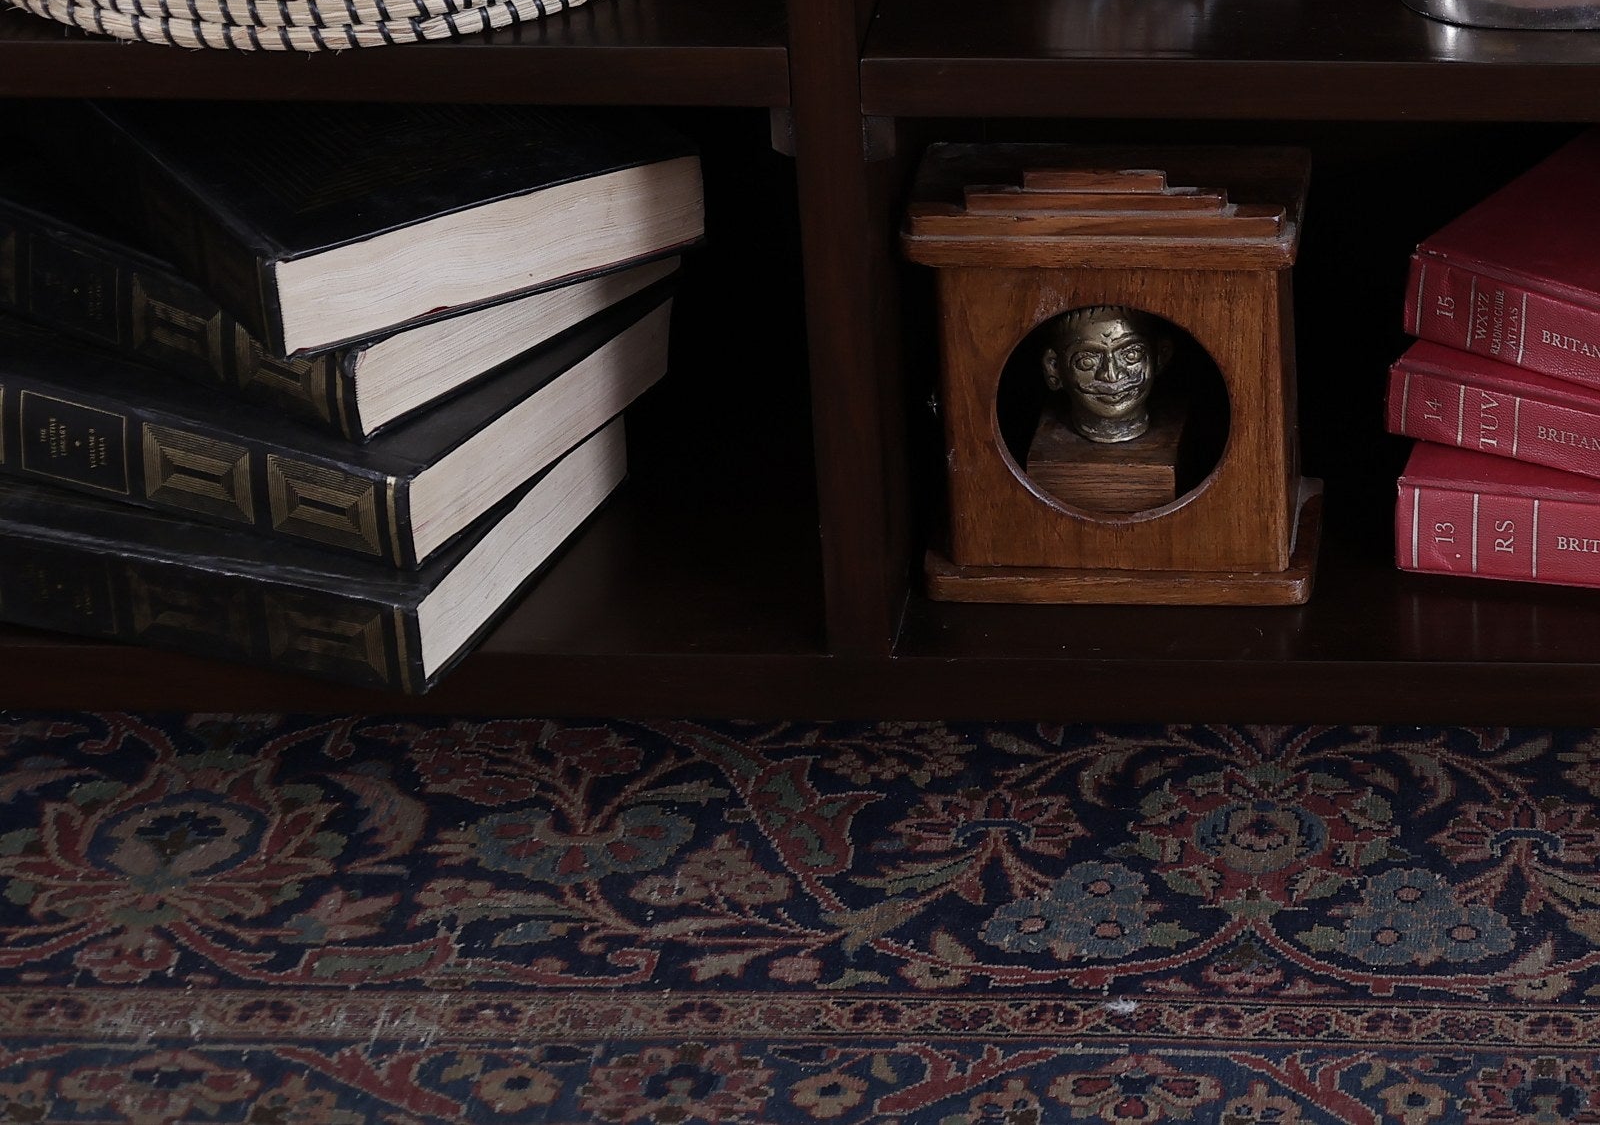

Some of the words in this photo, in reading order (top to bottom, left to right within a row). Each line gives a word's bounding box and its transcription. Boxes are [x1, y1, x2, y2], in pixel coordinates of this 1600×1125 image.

[1436, 295, 1455, 319] 15
[1475, 293, 1490, 339] WXYZ
[1506, 306, 1520, 350] ATLAS
[1424, 398, 1442, 423] 14
[1479, 391, 1501, 449] TUV
[1435, 521, 1454, 545] 13
[1494, 520, 1516, 554] RS
